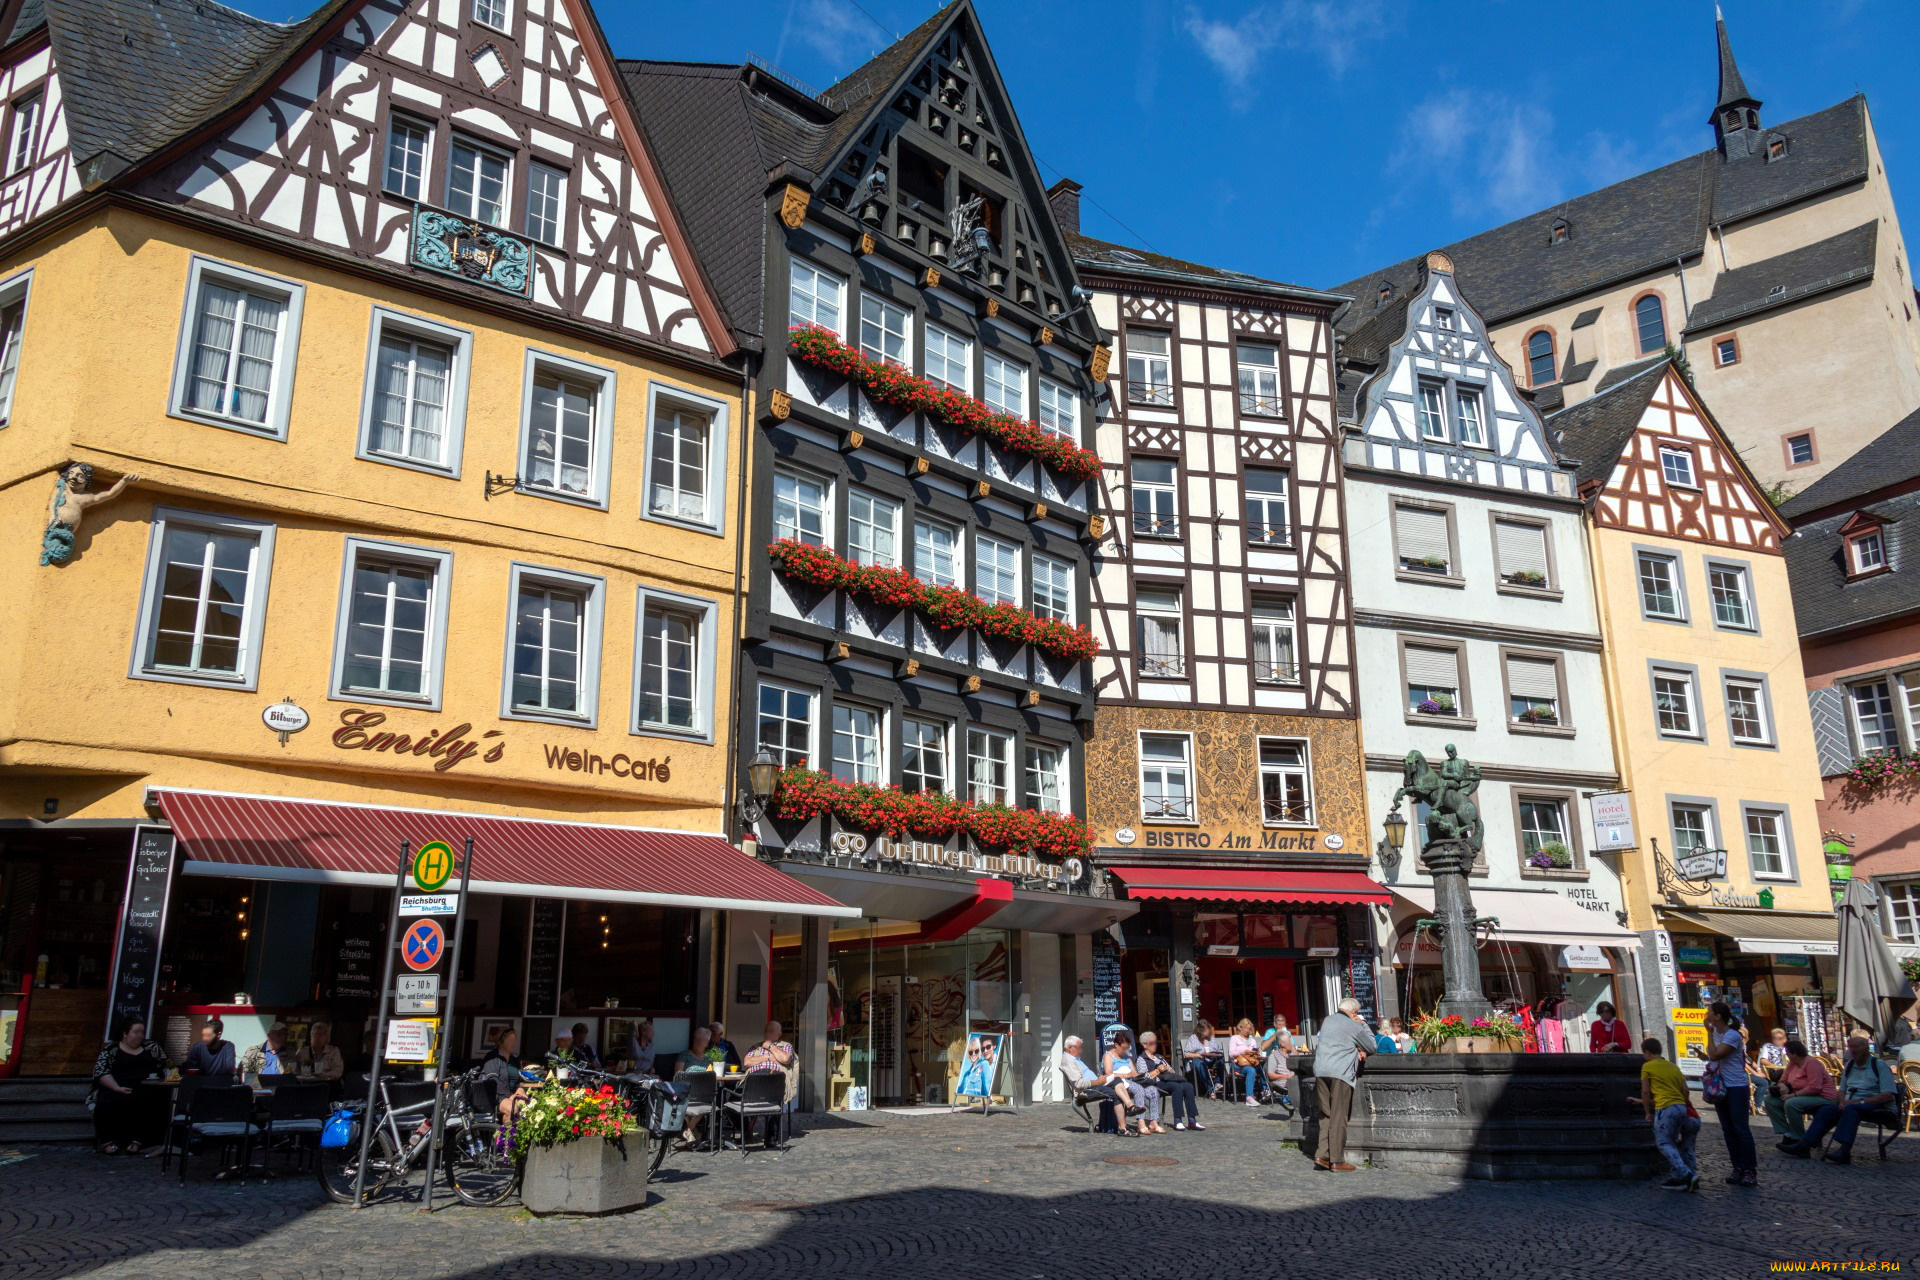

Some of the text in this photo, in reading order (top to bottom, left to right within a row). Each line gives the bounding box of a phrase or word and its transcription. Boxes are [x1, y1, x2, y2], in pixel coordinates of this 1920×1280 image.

[269, 711, 302, 724] Bitburger
[543, 743, 671, 783] Wein-Café
[1598, 804, 1625, 814] Hotel
[1146, 830, 1317, 851] BISTRO Am Markt
[1567, 888, 1598, 899] HOTEL
[1711, 885, 1759, 908] Reform
[402, 897, 447, 905] Reichsburg
[406, 981, 409, 989] 6
[418, 980, 424, 989] 10
